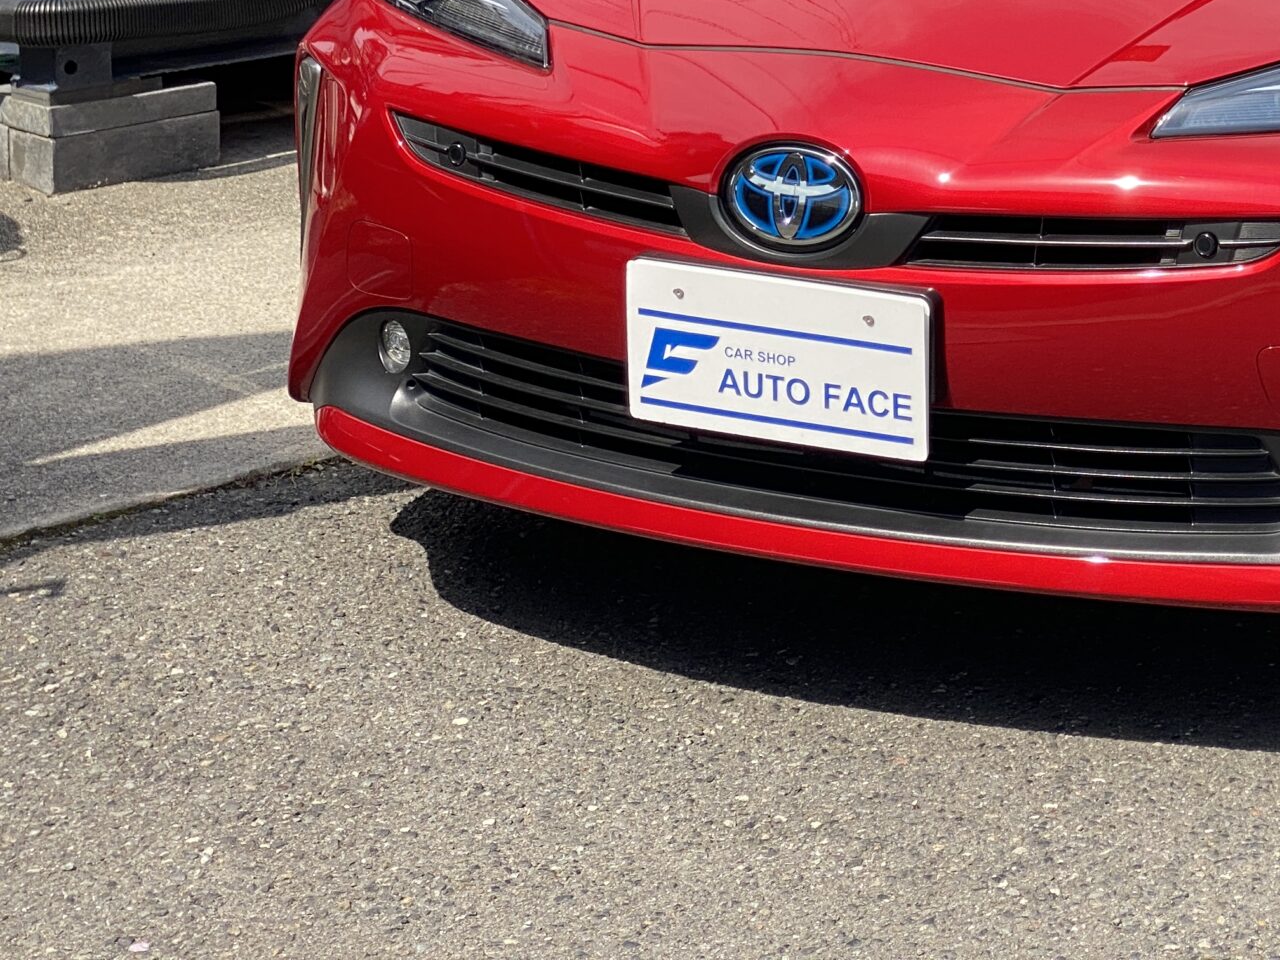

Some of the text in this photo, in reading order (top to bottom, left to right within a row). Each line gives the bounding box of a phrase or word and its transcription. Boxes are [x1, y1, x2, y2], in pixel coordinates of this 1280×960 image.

[724, 347, 796, 366] CAR SHOP
[718, 368, 913, 422] AUTO FACE
